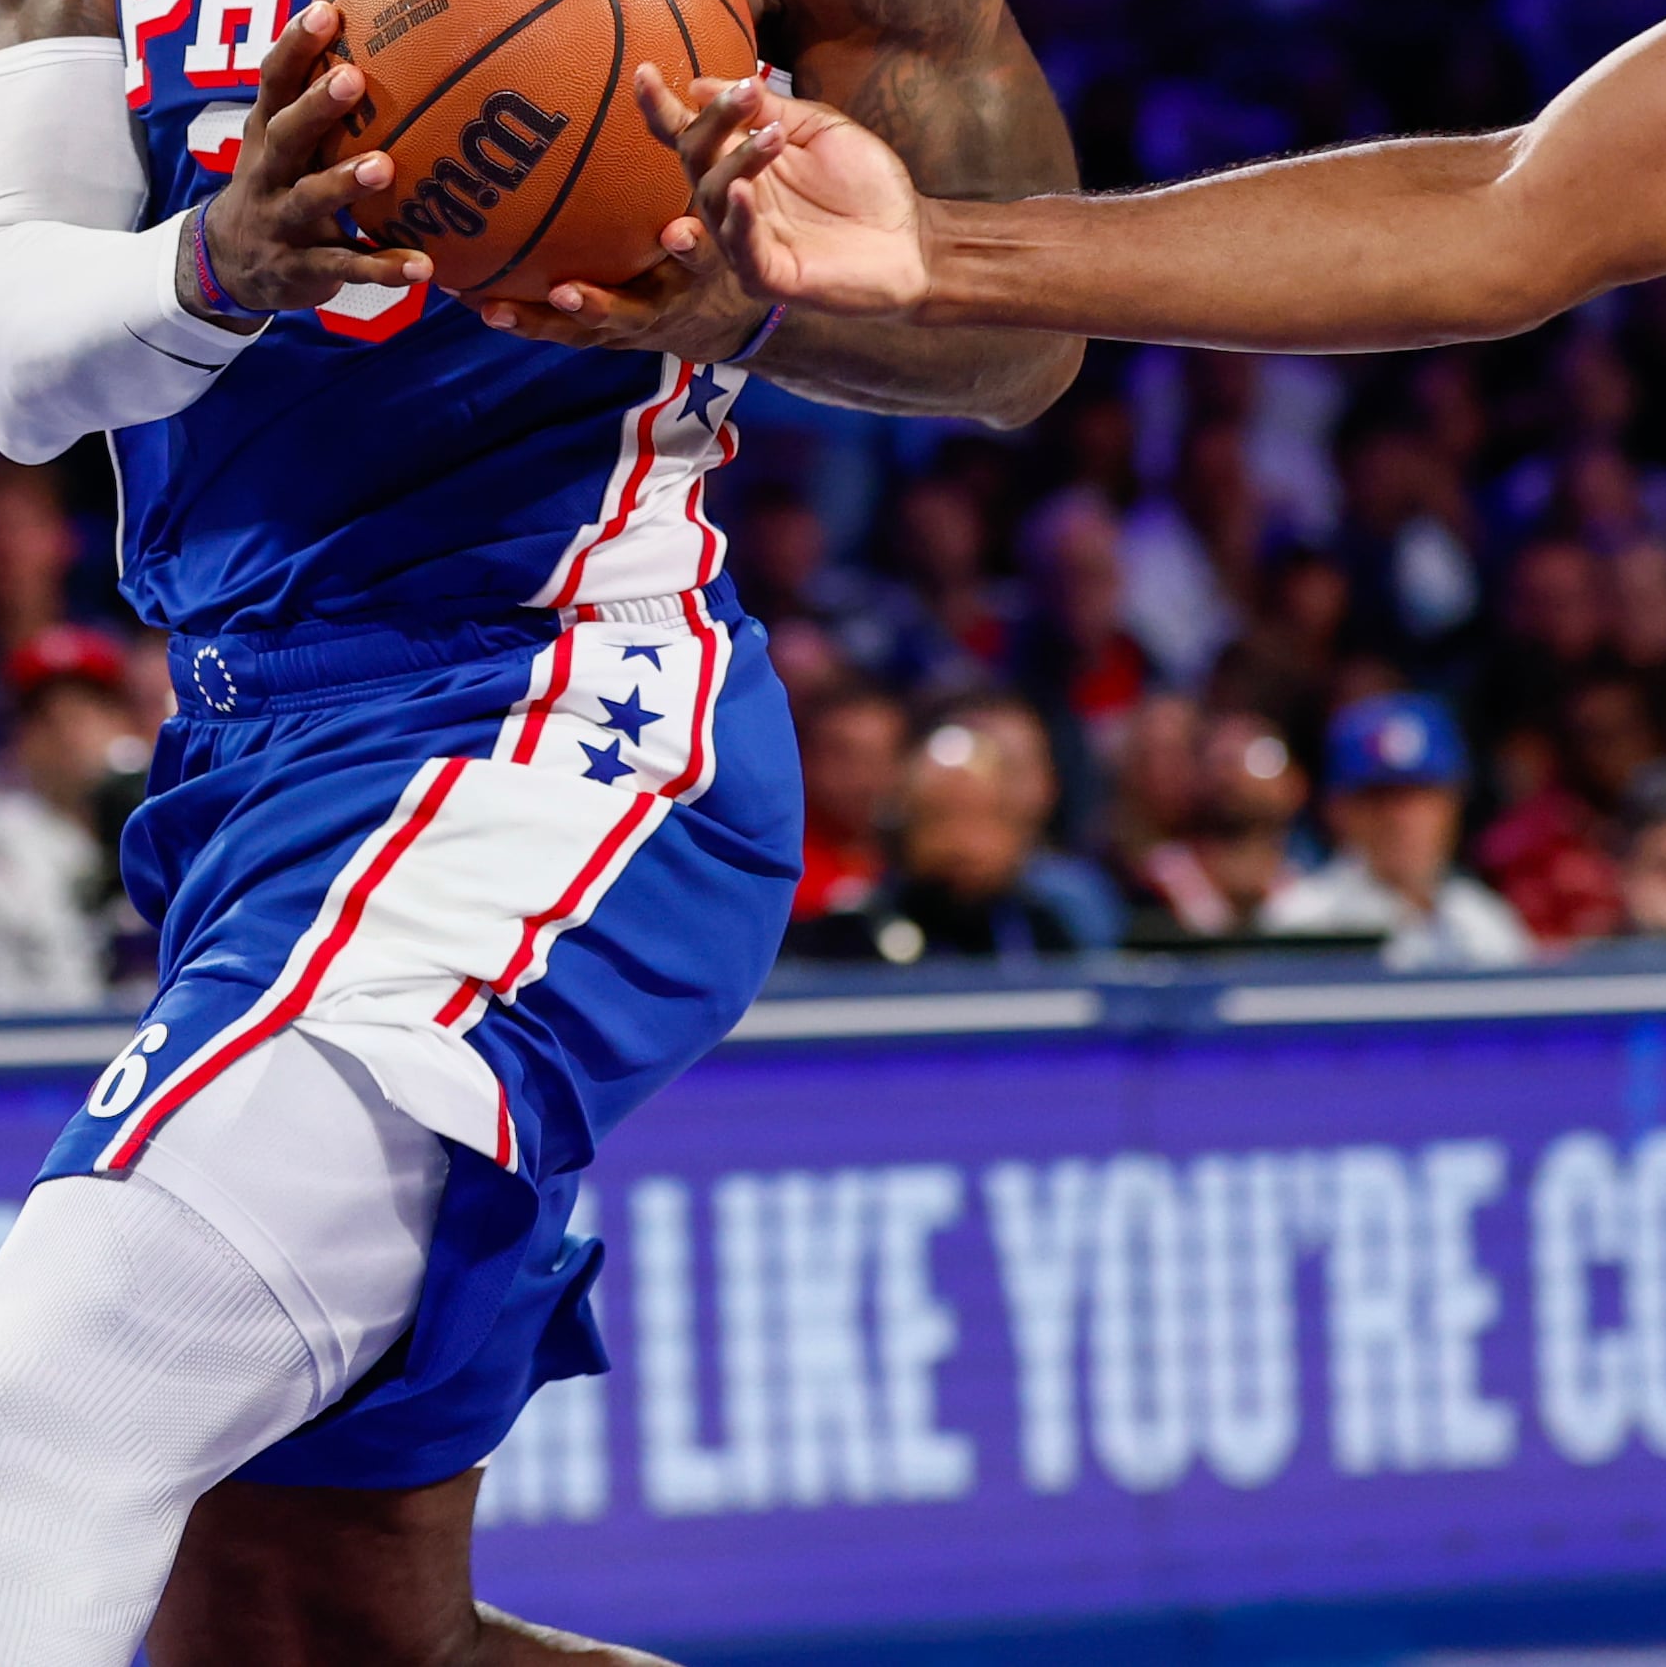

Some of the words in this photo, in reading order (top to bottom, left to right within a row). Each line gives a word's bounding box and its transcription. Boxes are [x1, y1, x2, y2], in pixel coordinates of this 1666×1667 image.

[373, 89, 571, 249] Wilso
[631, 1161, 978, 1517] LIKE
[981, 1141, 1517, 1495] YOU'RE
